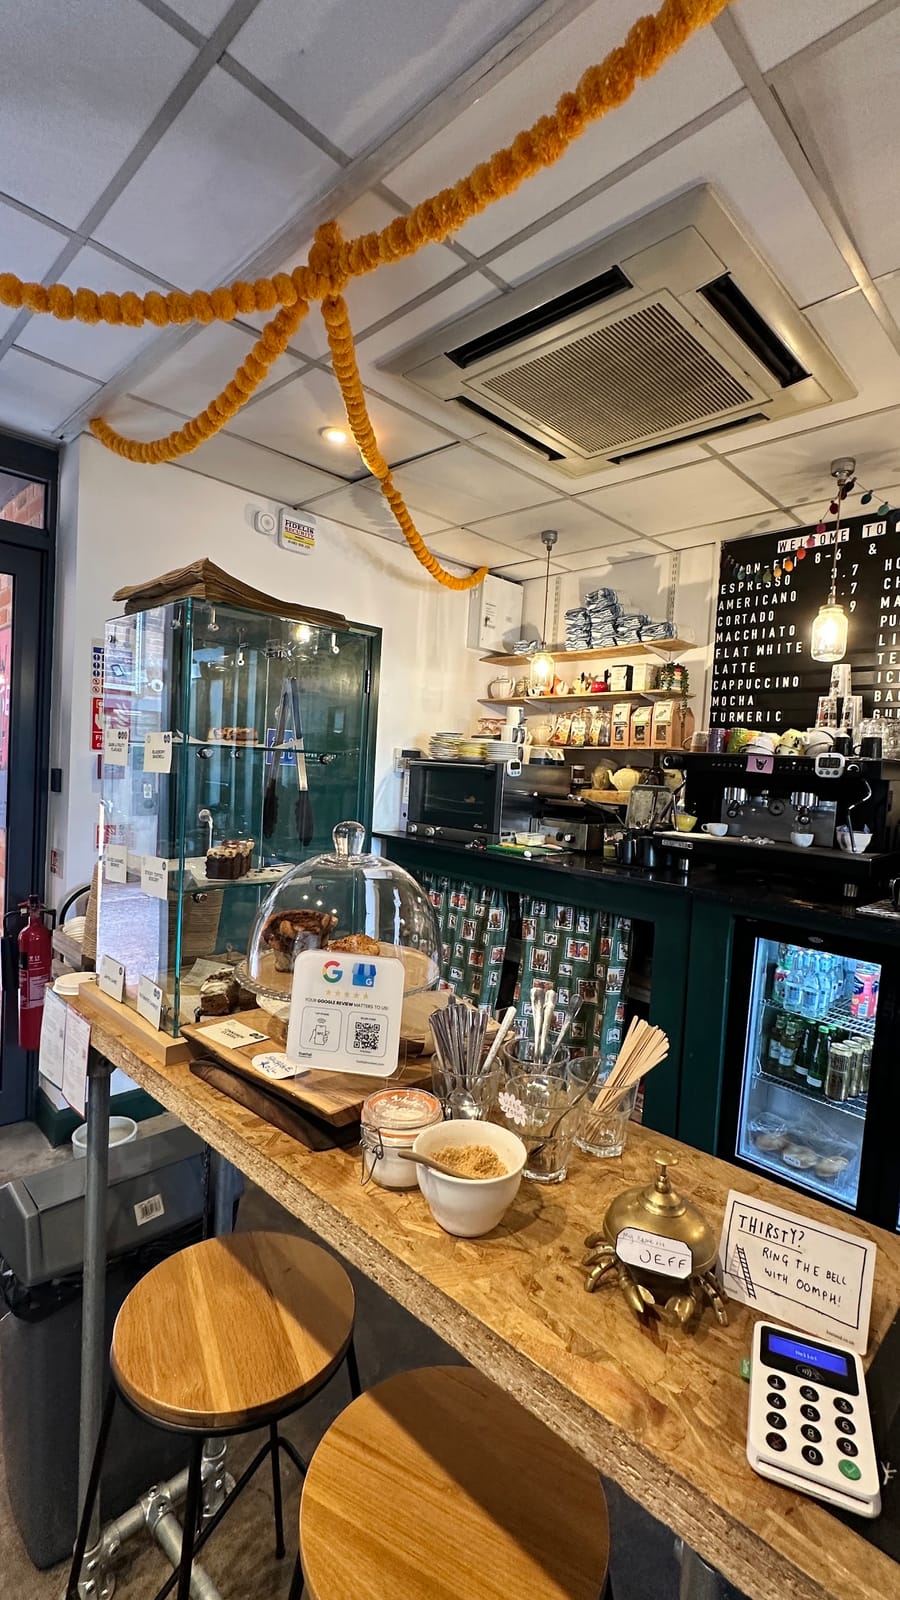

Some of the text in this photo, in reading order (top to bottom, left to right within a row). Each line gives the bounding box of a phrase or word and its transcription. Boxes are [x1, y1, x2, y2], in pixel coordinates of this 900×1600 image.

[779, 523, 884, 553] WELOME TO
[815, 549, 842, 563] 8-6
[868, 543, 877, 555] &
[721, 574, 791, 595] ESPRESSO
[719, 591, 797, 611] AMERICANO
[717, 610, 775, 627] CORTADO
[880, 614, 900, 628] PU
[716, 625, 796, 643] MACCHIATO
[715, 642, 803, 659] FLAT WHITE
[714, 662, 756, 675] LATTE
[713, 676, 799, 691] CAPPUCCINO
[712, 695, 754, 707] MOCHA
[712, 711, 782, 723] TURMERIC
[738, 1214, 805, 1248] THIRSTY?
[640, 1249, 687, 1269] JEFF
[762, 1247, 847, 1285] RING THE BELL
[764, 1267, 842, 1307] WITH OOMPH!
[840, 1401, 847, 1410] 3
[806, 1408, 814, 1417] 5
[841, 1421, 849, 1430] 6
[772, 1416, 851, 1451] 7 8 9
[808, 1450, 817, 1460] 0
